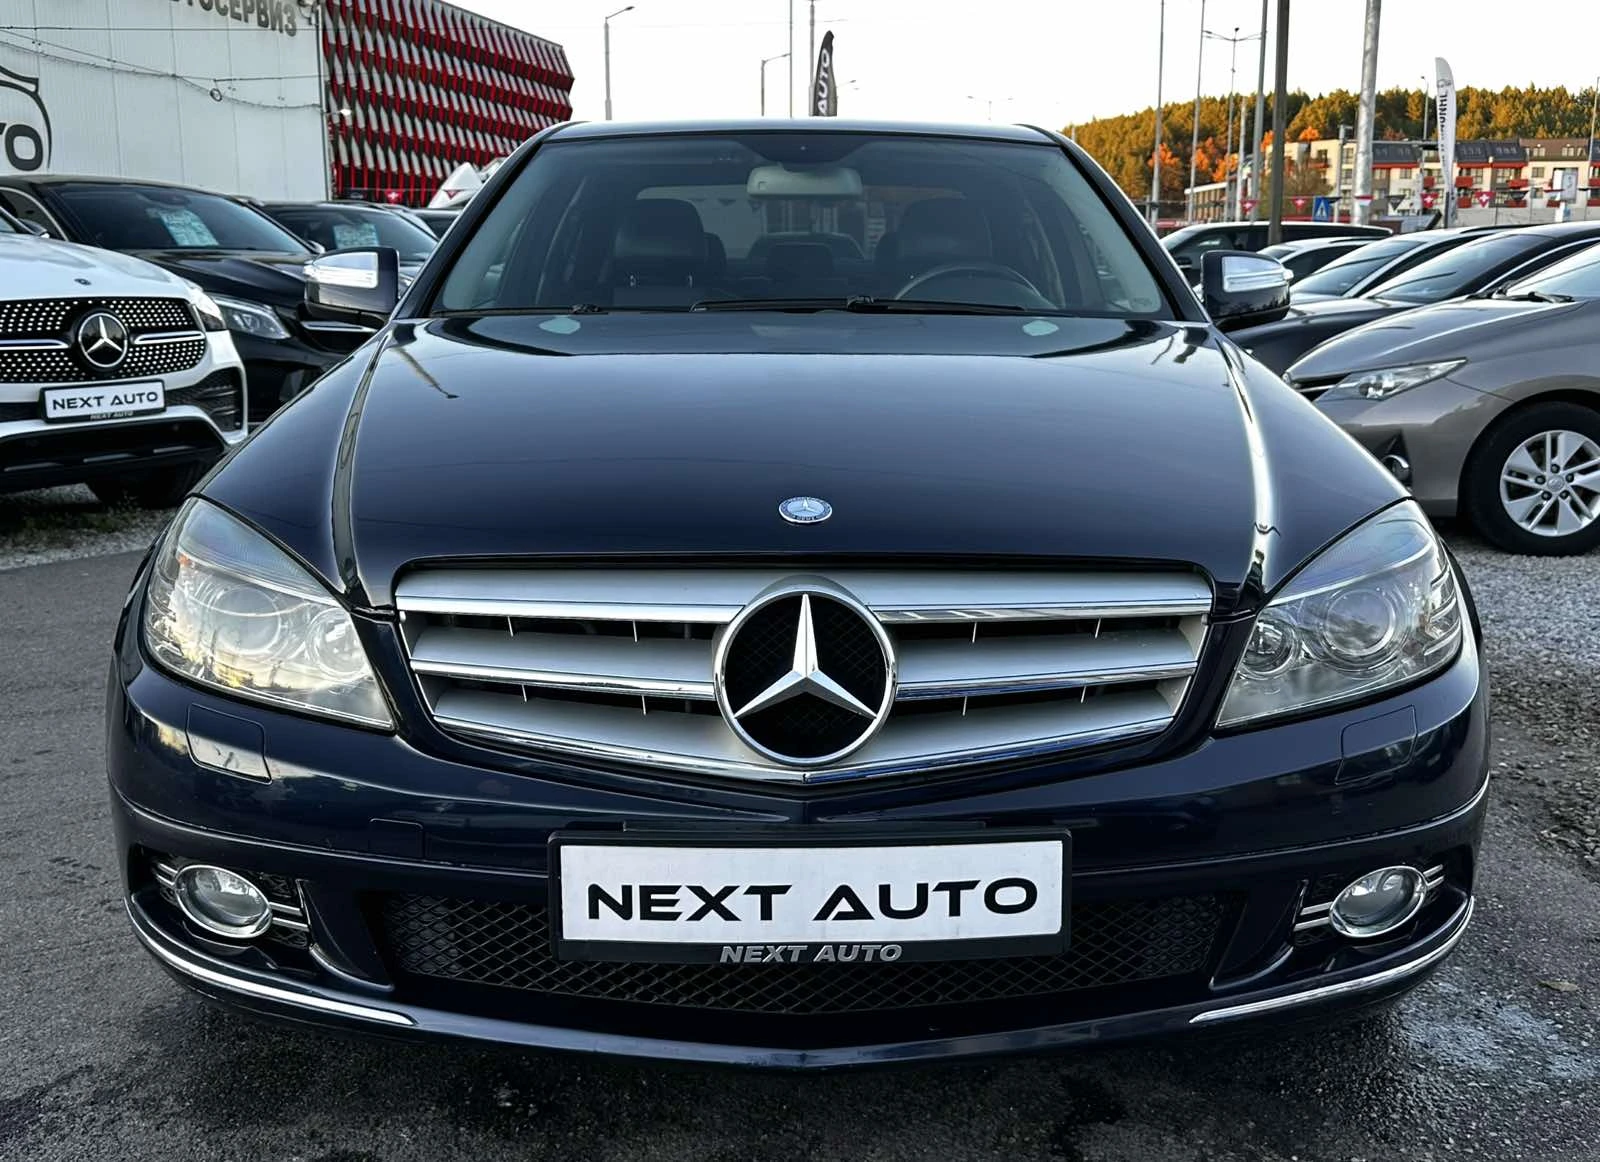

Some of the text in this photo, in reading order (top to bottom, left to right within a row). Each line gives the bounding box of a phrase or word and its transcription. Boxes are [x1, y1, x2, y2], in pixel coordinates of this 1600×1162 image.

[818, 48, 830, 115] AUTO
[0, 122, 44, 172] O
[52, 391, 159, 410] NEXT AUTO
[587, 877, 1039, 922] NEXT AUTO
[720, 944, 903, 963] NEXT AUTO
